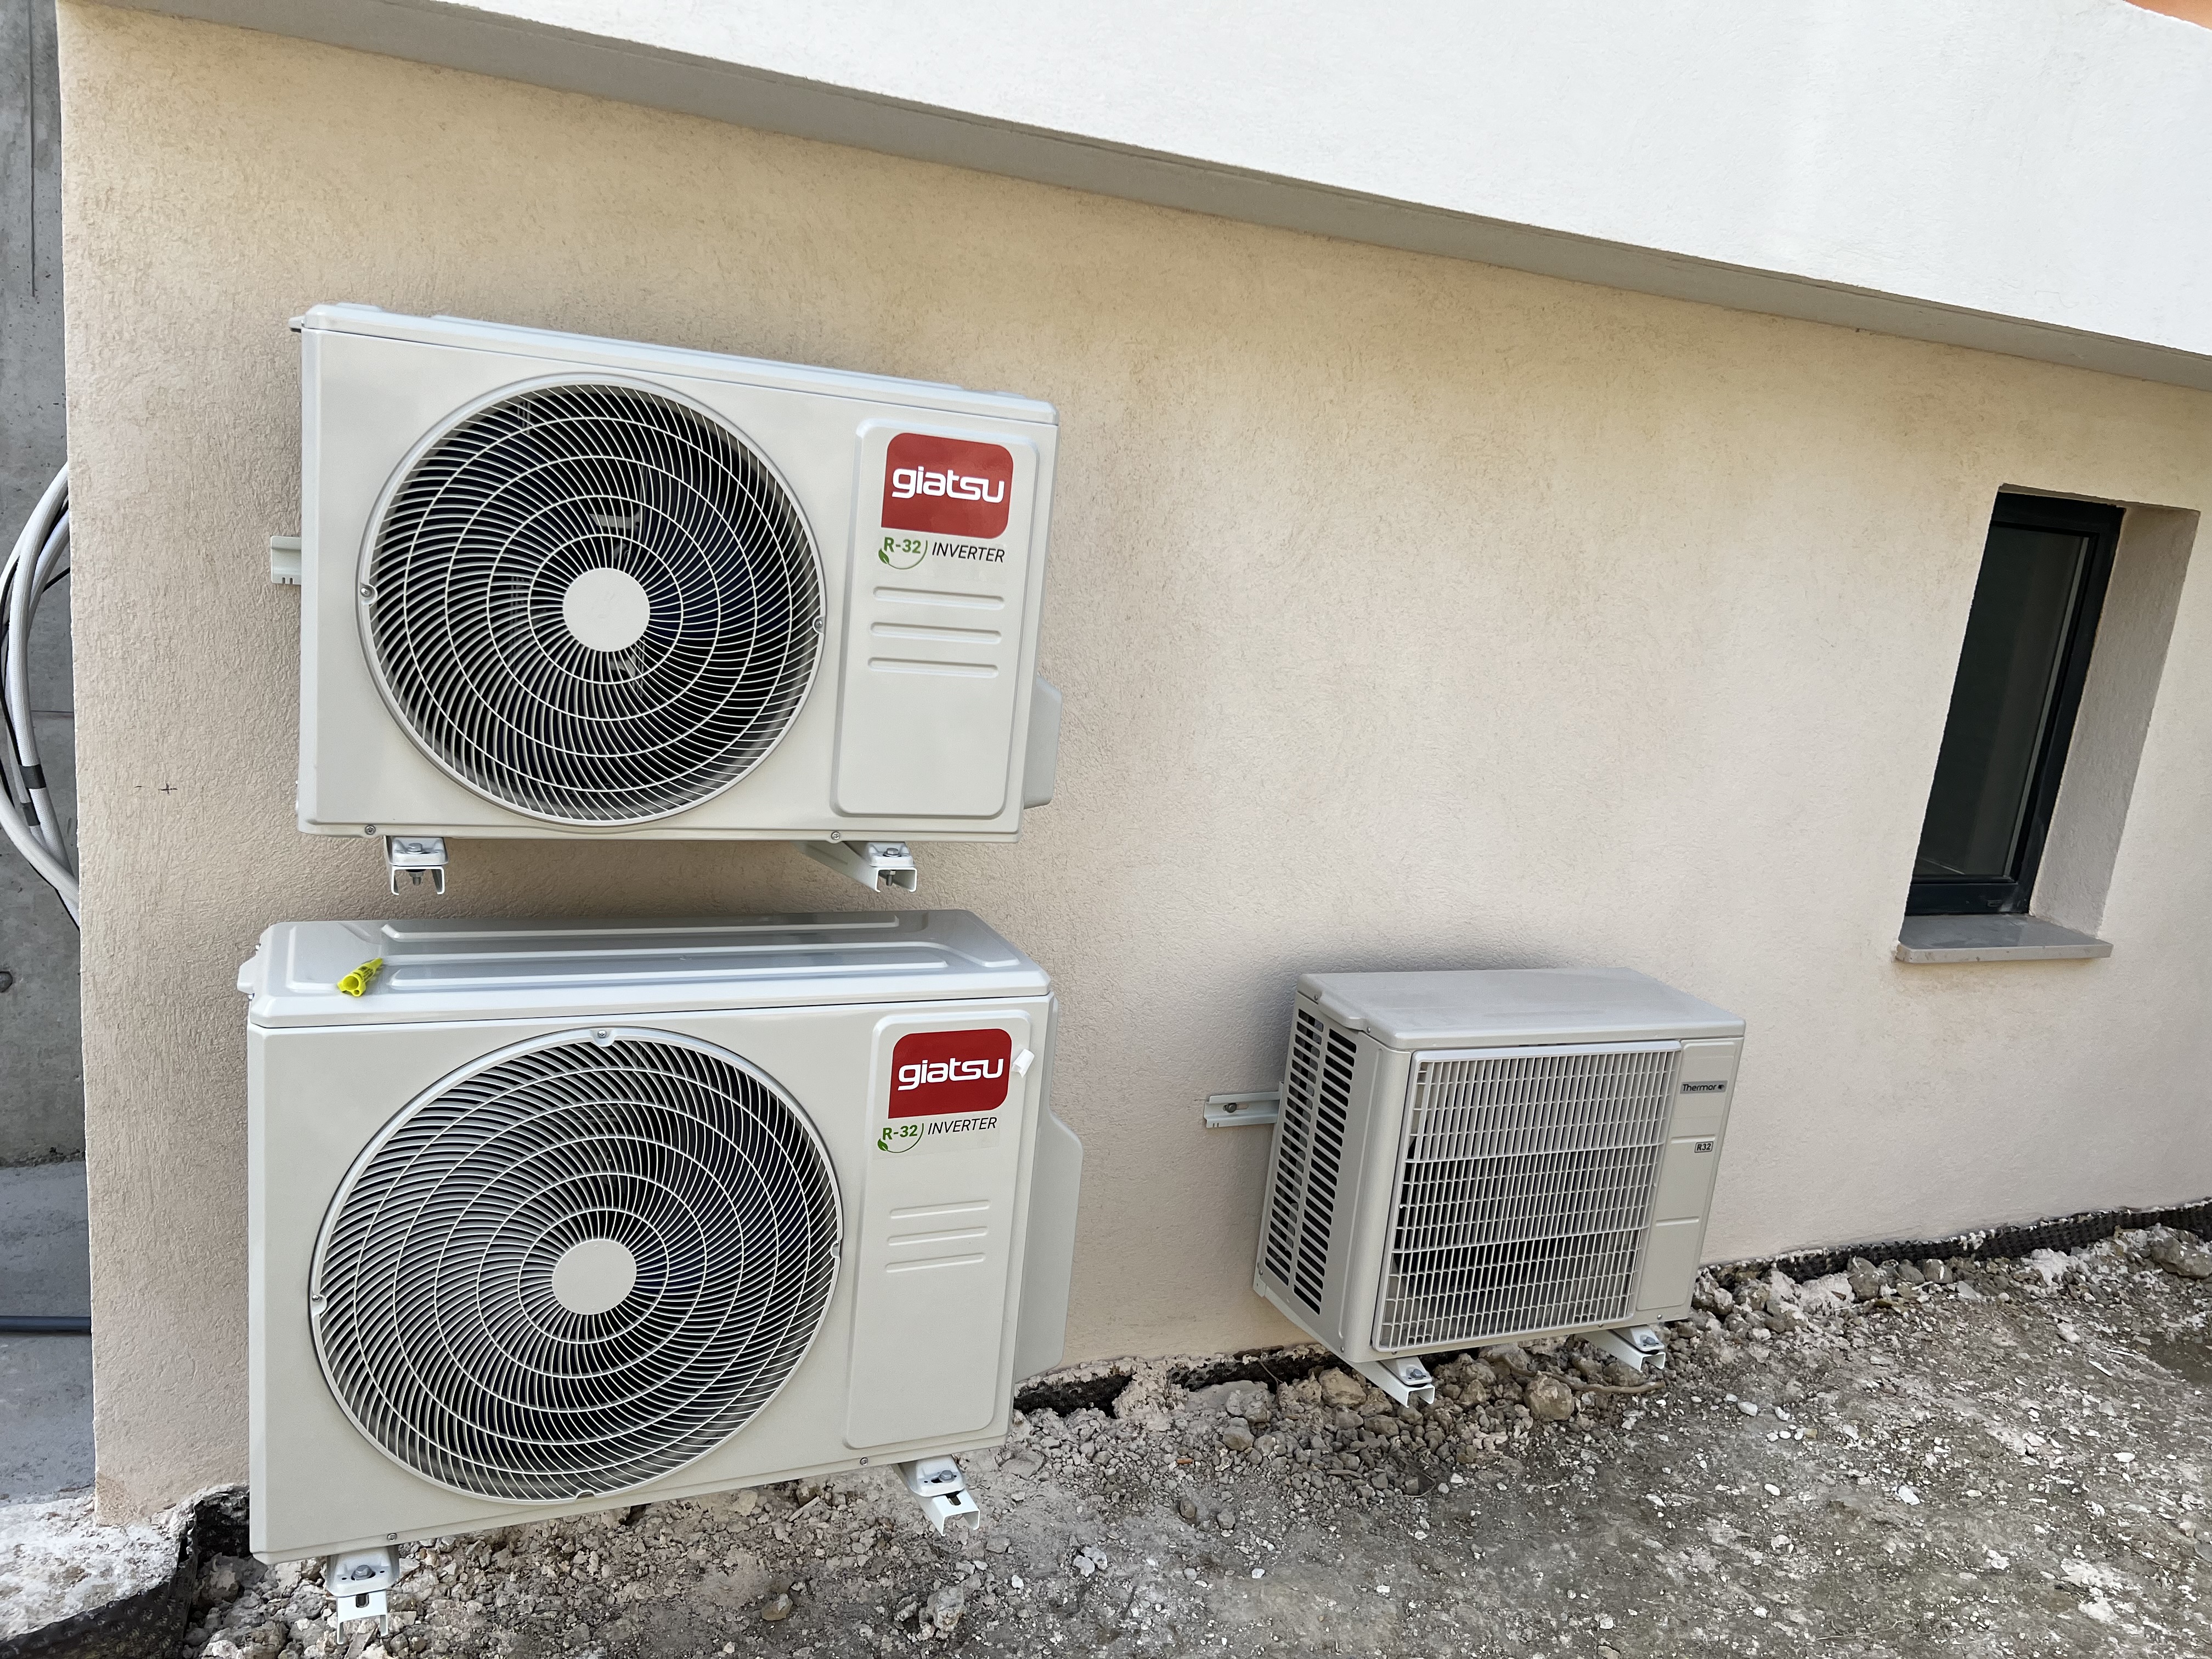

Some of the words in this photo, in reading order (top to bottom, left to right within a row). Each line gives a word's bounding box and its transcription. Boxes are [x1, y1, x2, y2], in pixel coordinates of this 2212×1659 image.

[892, 466, 1005, 503] giatsu
[883, 537, 921, 554] R-32
[932, 542, 1005, 563] INVERTER
[898, 1058, 1004, 1091] giatsu
[882, 1125, 918, 1141] R-32
[928, 1117, 997, 1135] INVERTER
